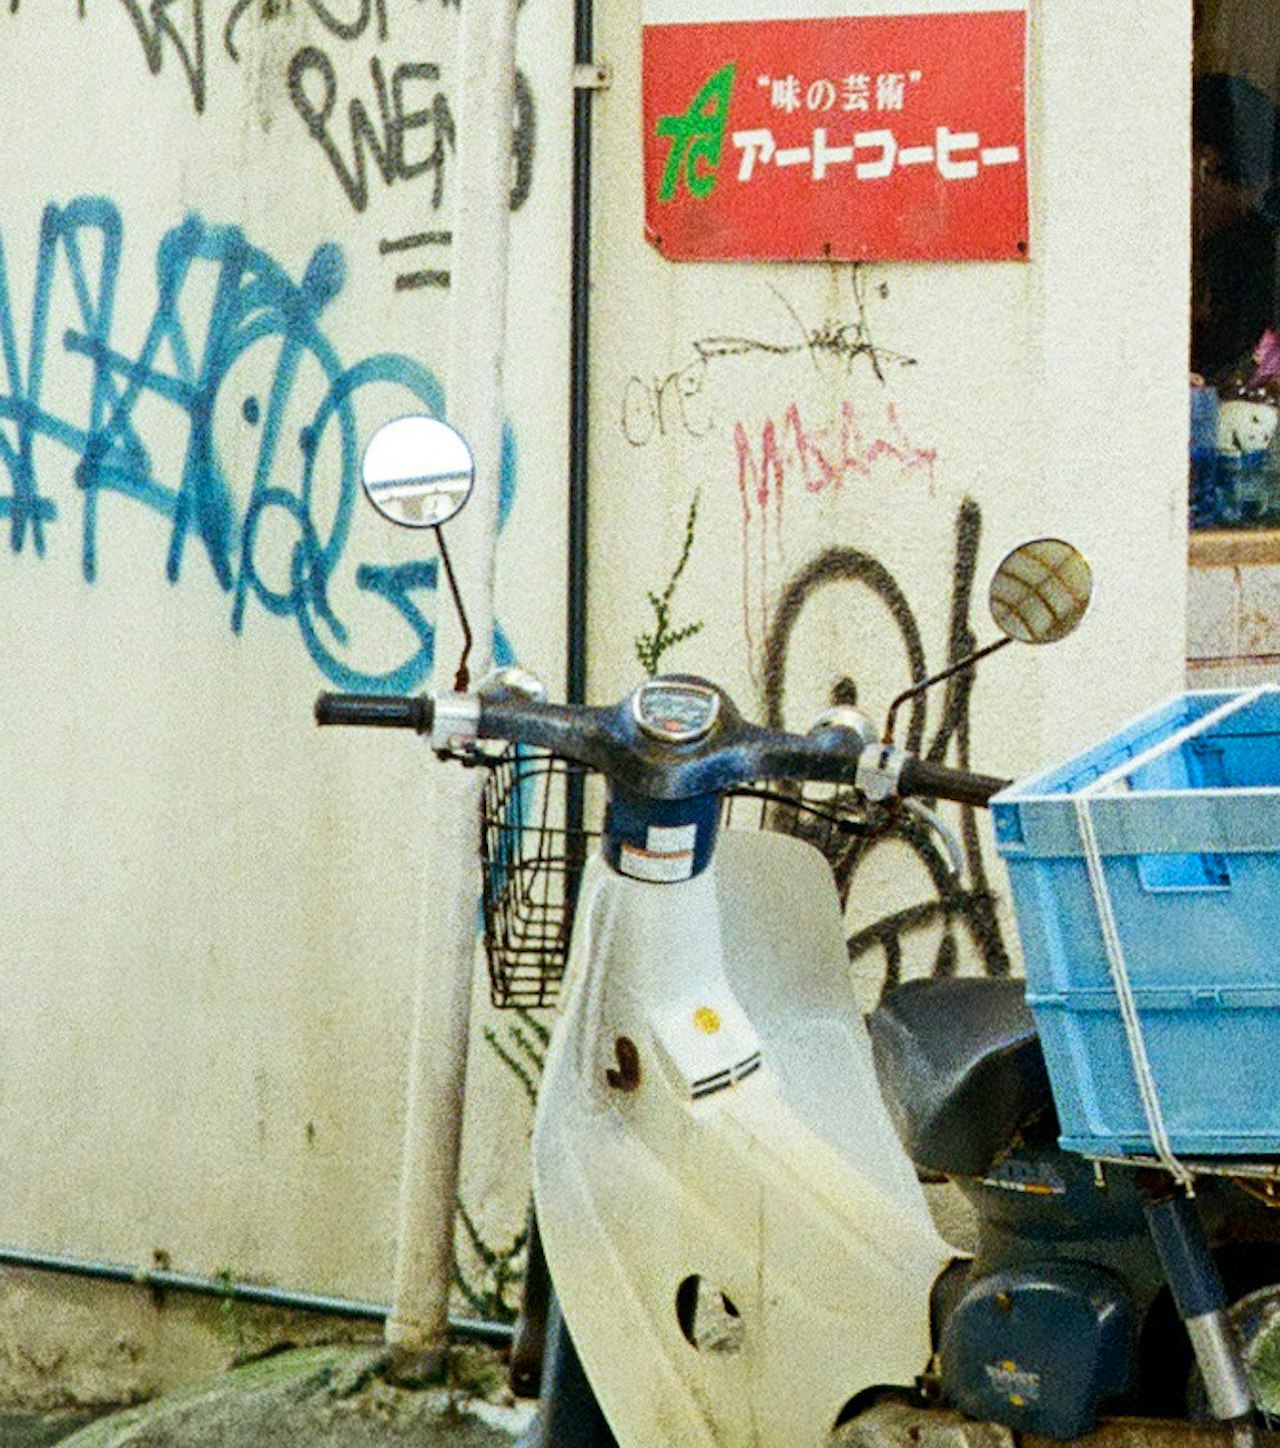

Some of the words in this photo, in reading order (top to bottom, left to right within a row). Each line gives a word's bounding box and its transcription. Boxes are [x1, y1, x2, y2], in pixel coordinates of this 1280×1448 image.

[731, 124, 1020, 183] アートコーヒー
